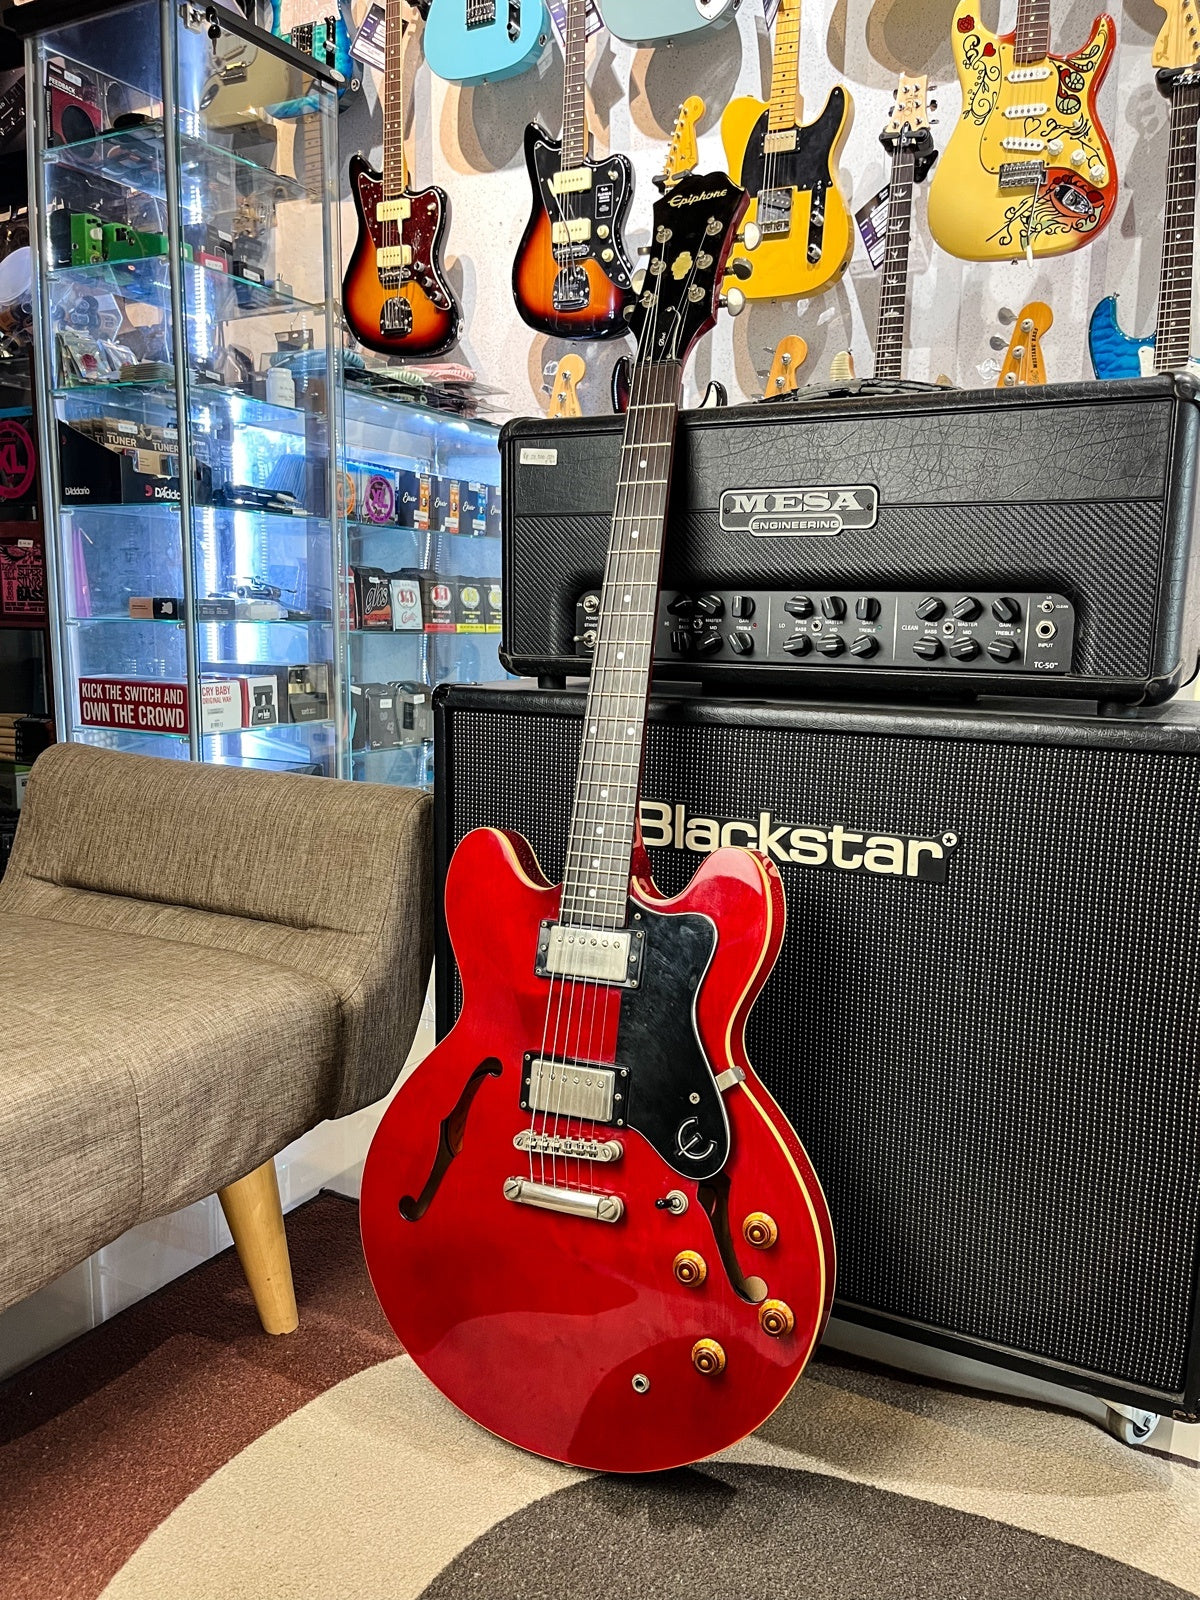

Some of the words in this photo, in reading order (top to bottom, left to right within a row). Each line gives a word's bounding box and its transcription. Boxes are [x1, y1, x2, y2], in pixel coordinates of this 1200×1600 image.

[668, 188, 728, 208] Epiphone
[106, 434, 137, 447] TUNER
[152, 442, 179, 453] TUNER
[64, 486, 91, 496] D'Addario
[731, 491, 864, 514] MESA
[752, 520, 840, 530] ENGINEERING
[365, 582, 388, 615] ghs
[81, 683, 104, 699] KICK
[104, 684, 122, 700] THE
[124, 685, 161, 703] SWITCH
[163, 688, 184, 705] AND
[201, 686, 214, 697] CRY
[215, 685, 231, 695] BABY
[82, 701, 111, 722] OWN
[112, 703, 136, 725] THE
[138, 705, 185, 729] CROWD
[639, 800, 944, 877] Blackstar
